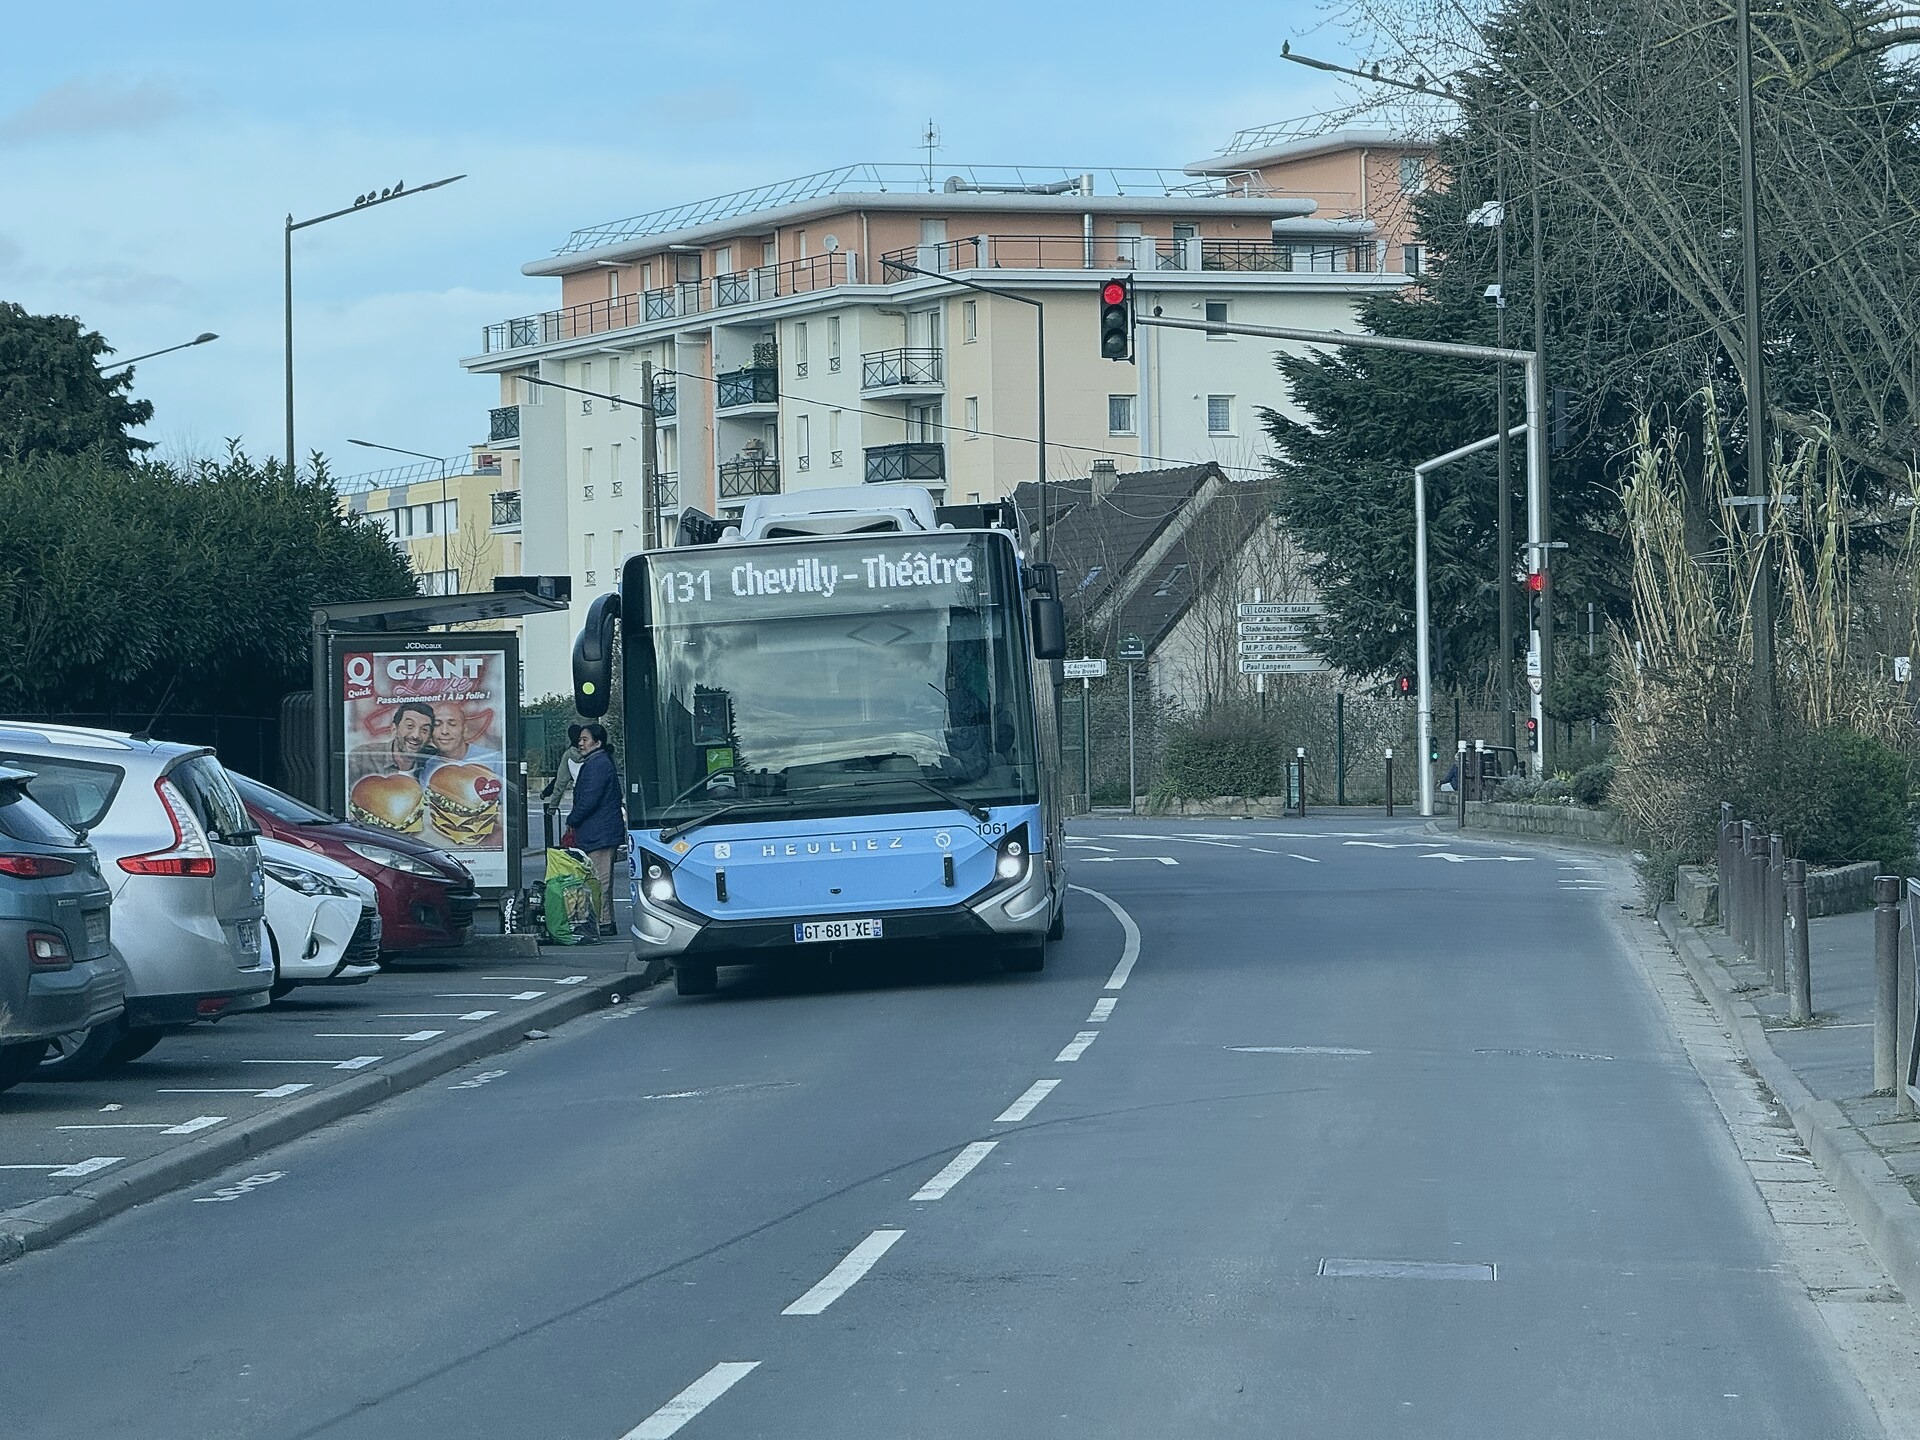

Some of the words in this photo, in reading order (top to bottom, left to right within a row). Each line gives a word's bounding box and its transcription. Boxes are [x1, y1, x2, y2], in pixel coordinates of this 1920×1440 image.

[661, 569, 711, 603] 131
[731, 558, 838, 598] Chevilly
[862, 551, 974, 589] Théâtre
[405, 642, 442, 650] JCDecaux
[386, 658, 483, 680] GIANT
[1262, 663, 1291, 671] Langevin
[392, 662, 475, 696] Love
[348, 687, 372, 699] Quick
[466, 691, 486, 700] folie
[976, 822, 1008, 836] 1061
[762, 836, 903, 857] HEULIEZ
[804, 922, 872, 939] GT-681-XE
